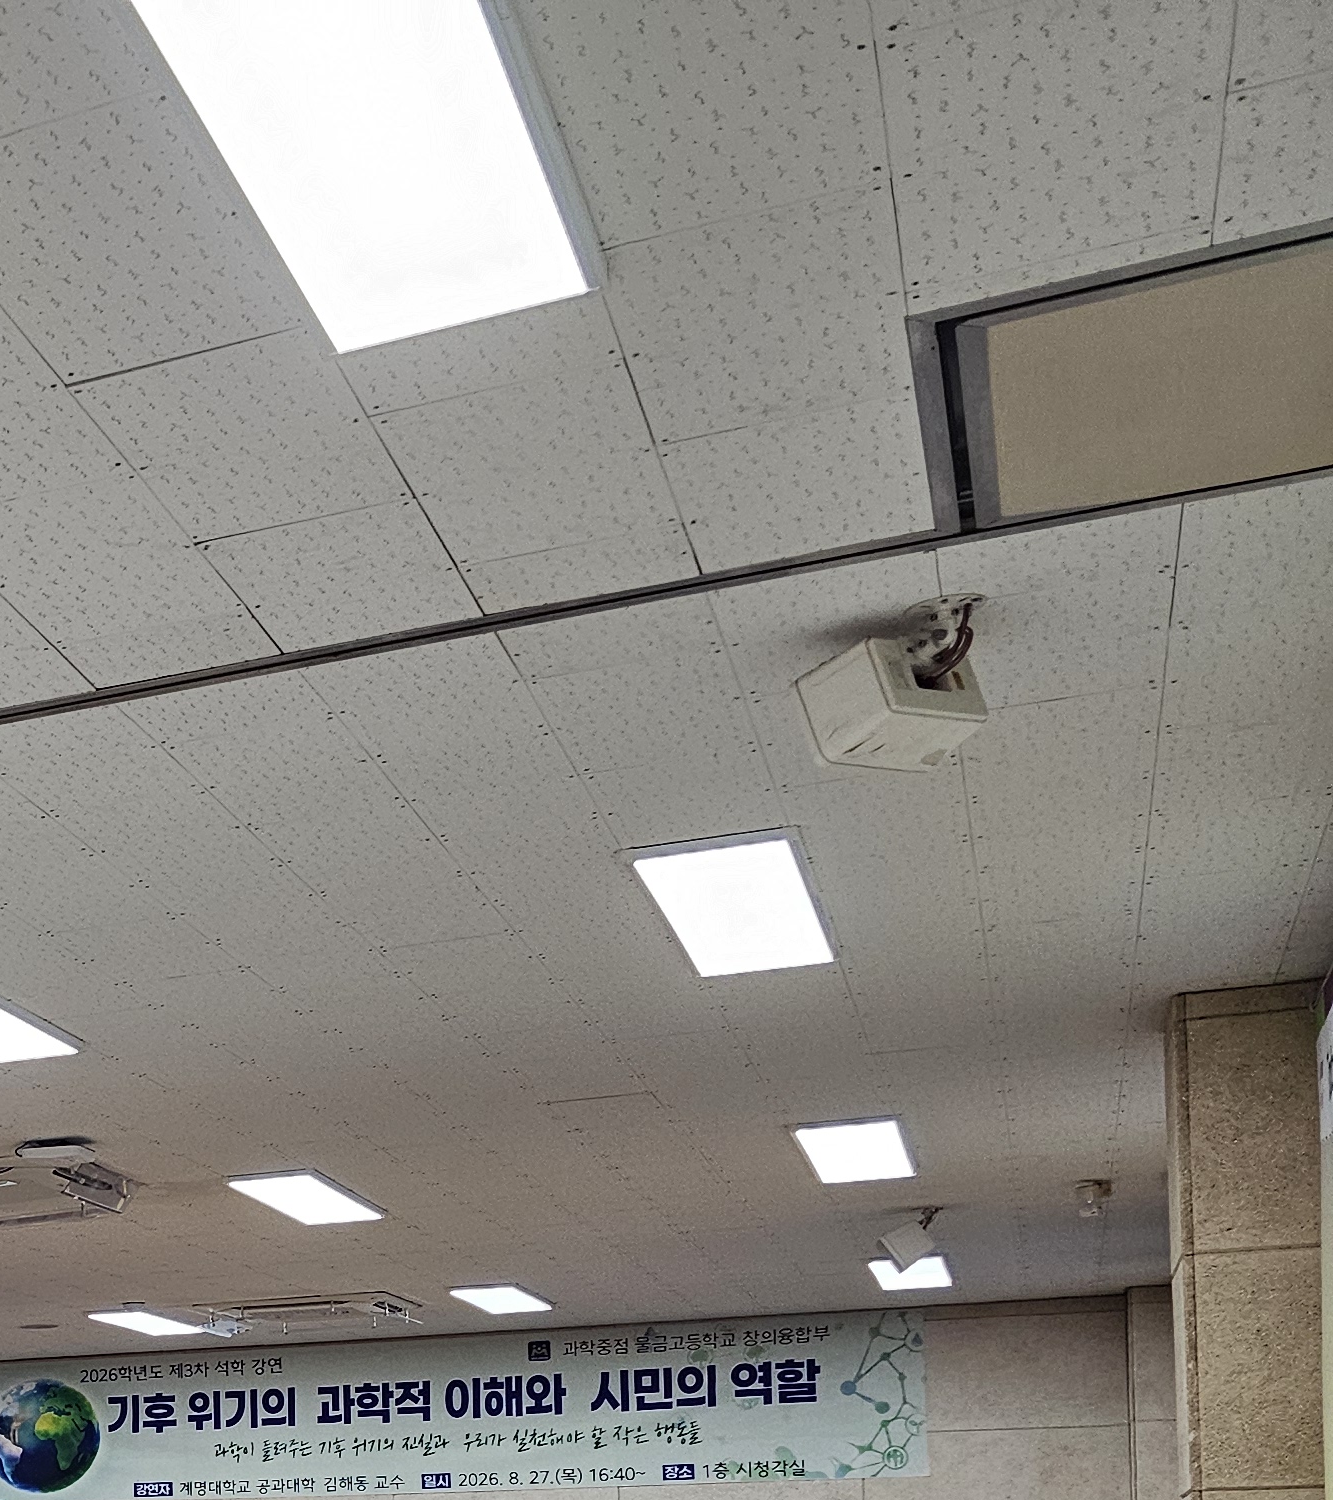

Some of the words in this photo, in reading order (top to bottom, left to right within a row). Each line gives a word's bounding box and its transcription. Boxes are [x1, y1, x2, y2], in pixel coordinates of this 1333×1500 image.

[563, 1338, 629, 1356] 과학중점
[635, 1332, 736, 1353] 물금고등학교
[742, 1325, 830, 1347] 창의융합부
[80, 1365, 164, 1383] 2026학년도
[169, 1364, 209, 1379] 제3차
[215, 1360, 246, 1376] 석학
[252, 1357, 283, 1375] 강연
[108, 1393, 177, 1433] 기후
[188, 1387, 295, 1430] 위기의
[316, 1380, 431, 1425] 과학적
[445, 1373, 567, 1419] 이해와
[590, 1364, 716, 1412] 시민의
[730, 1359, 821, 1405] 역할
[214, 1441, 254, 1463] 과학이
[261, 1438, 312, 1462] 들려주는
[319, 1437, 345, 1458] 기후
[352, 1437, 394, 1456] 위기의
[402, 1433, 449, 1456] 진실과
[463, 1433, 506, 1452] 우리가
[513, 1428, 585, 1452] 실천해야
[590, 1426, 607, 1448] 할
[612, 1425, 649, 1446] 작은
[654, 1420, 703, 1445] 행동들
[423, 1474, 449, 1488] 일시
[458, 1472, 502, 1487] 2026.
[509, 1472, 523, 1485] 8.
[529, 1468, 582, 1485] 27.(목)
[589, 1466, 646, 1482] 16:40~
[665, 1464, 693, 1480] 장소
[703, 1462, 730, 1479] 1층
[736, 1459, 805, 1477] 시청각실
[136, 1484, 171, 1496] 강연자
[179, 1480, 251, 1496] 계명대학교
[256, 1477, 315, 1494] 공과대학
[323, 1475, 369, 1493] 김해동
[374, 1474, 405, 1490] 교수
